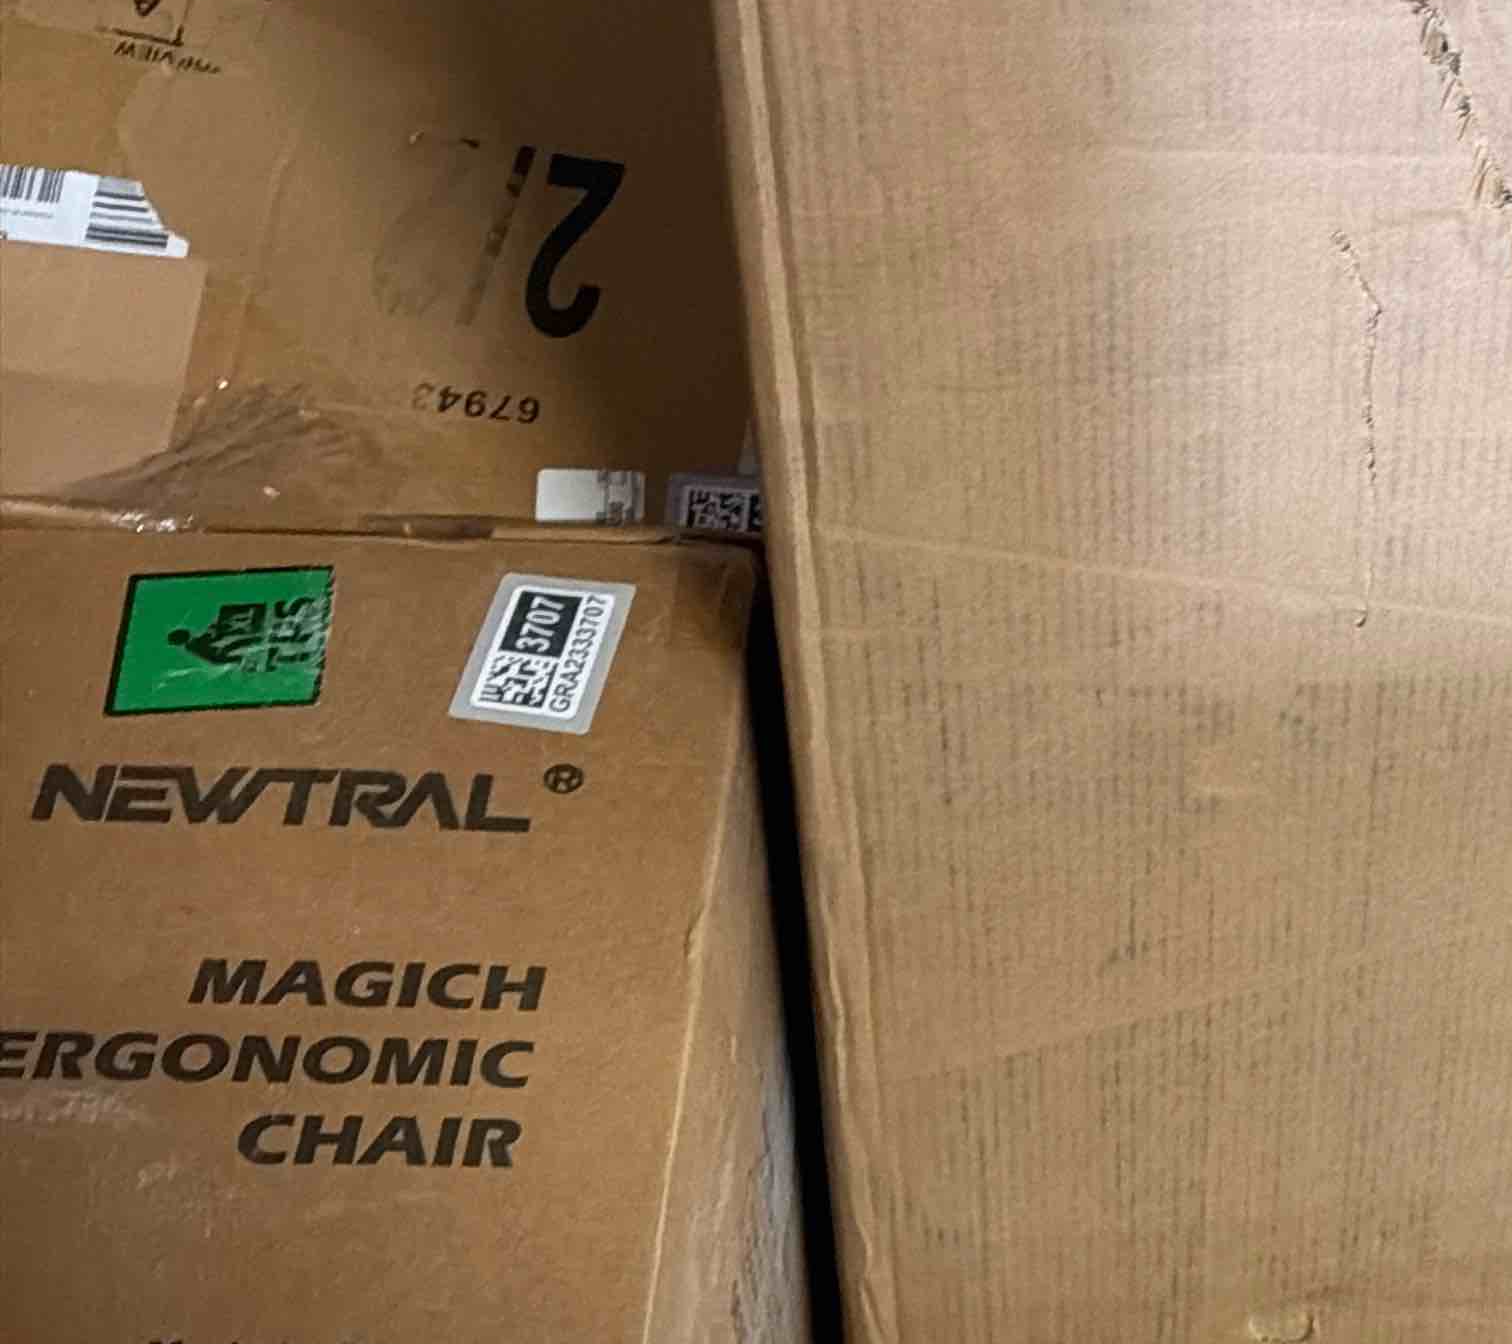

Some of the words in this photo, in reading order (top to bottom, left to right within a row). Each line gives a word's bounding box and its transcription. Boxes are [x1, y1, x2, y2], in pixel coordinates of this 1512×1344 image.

[523, 153, 625, 339] 2
[515, 596, 565, 653] 3707
[549, 594, 608, 713] GRA2333707
[31, 762, 532, 833] NEWTRAL
[187, 957, 548, 1012] MAGICH
[0, 1030, 536, 1089] ERGONOMIC
[236, 1113, 522, 1169] CHAIR
